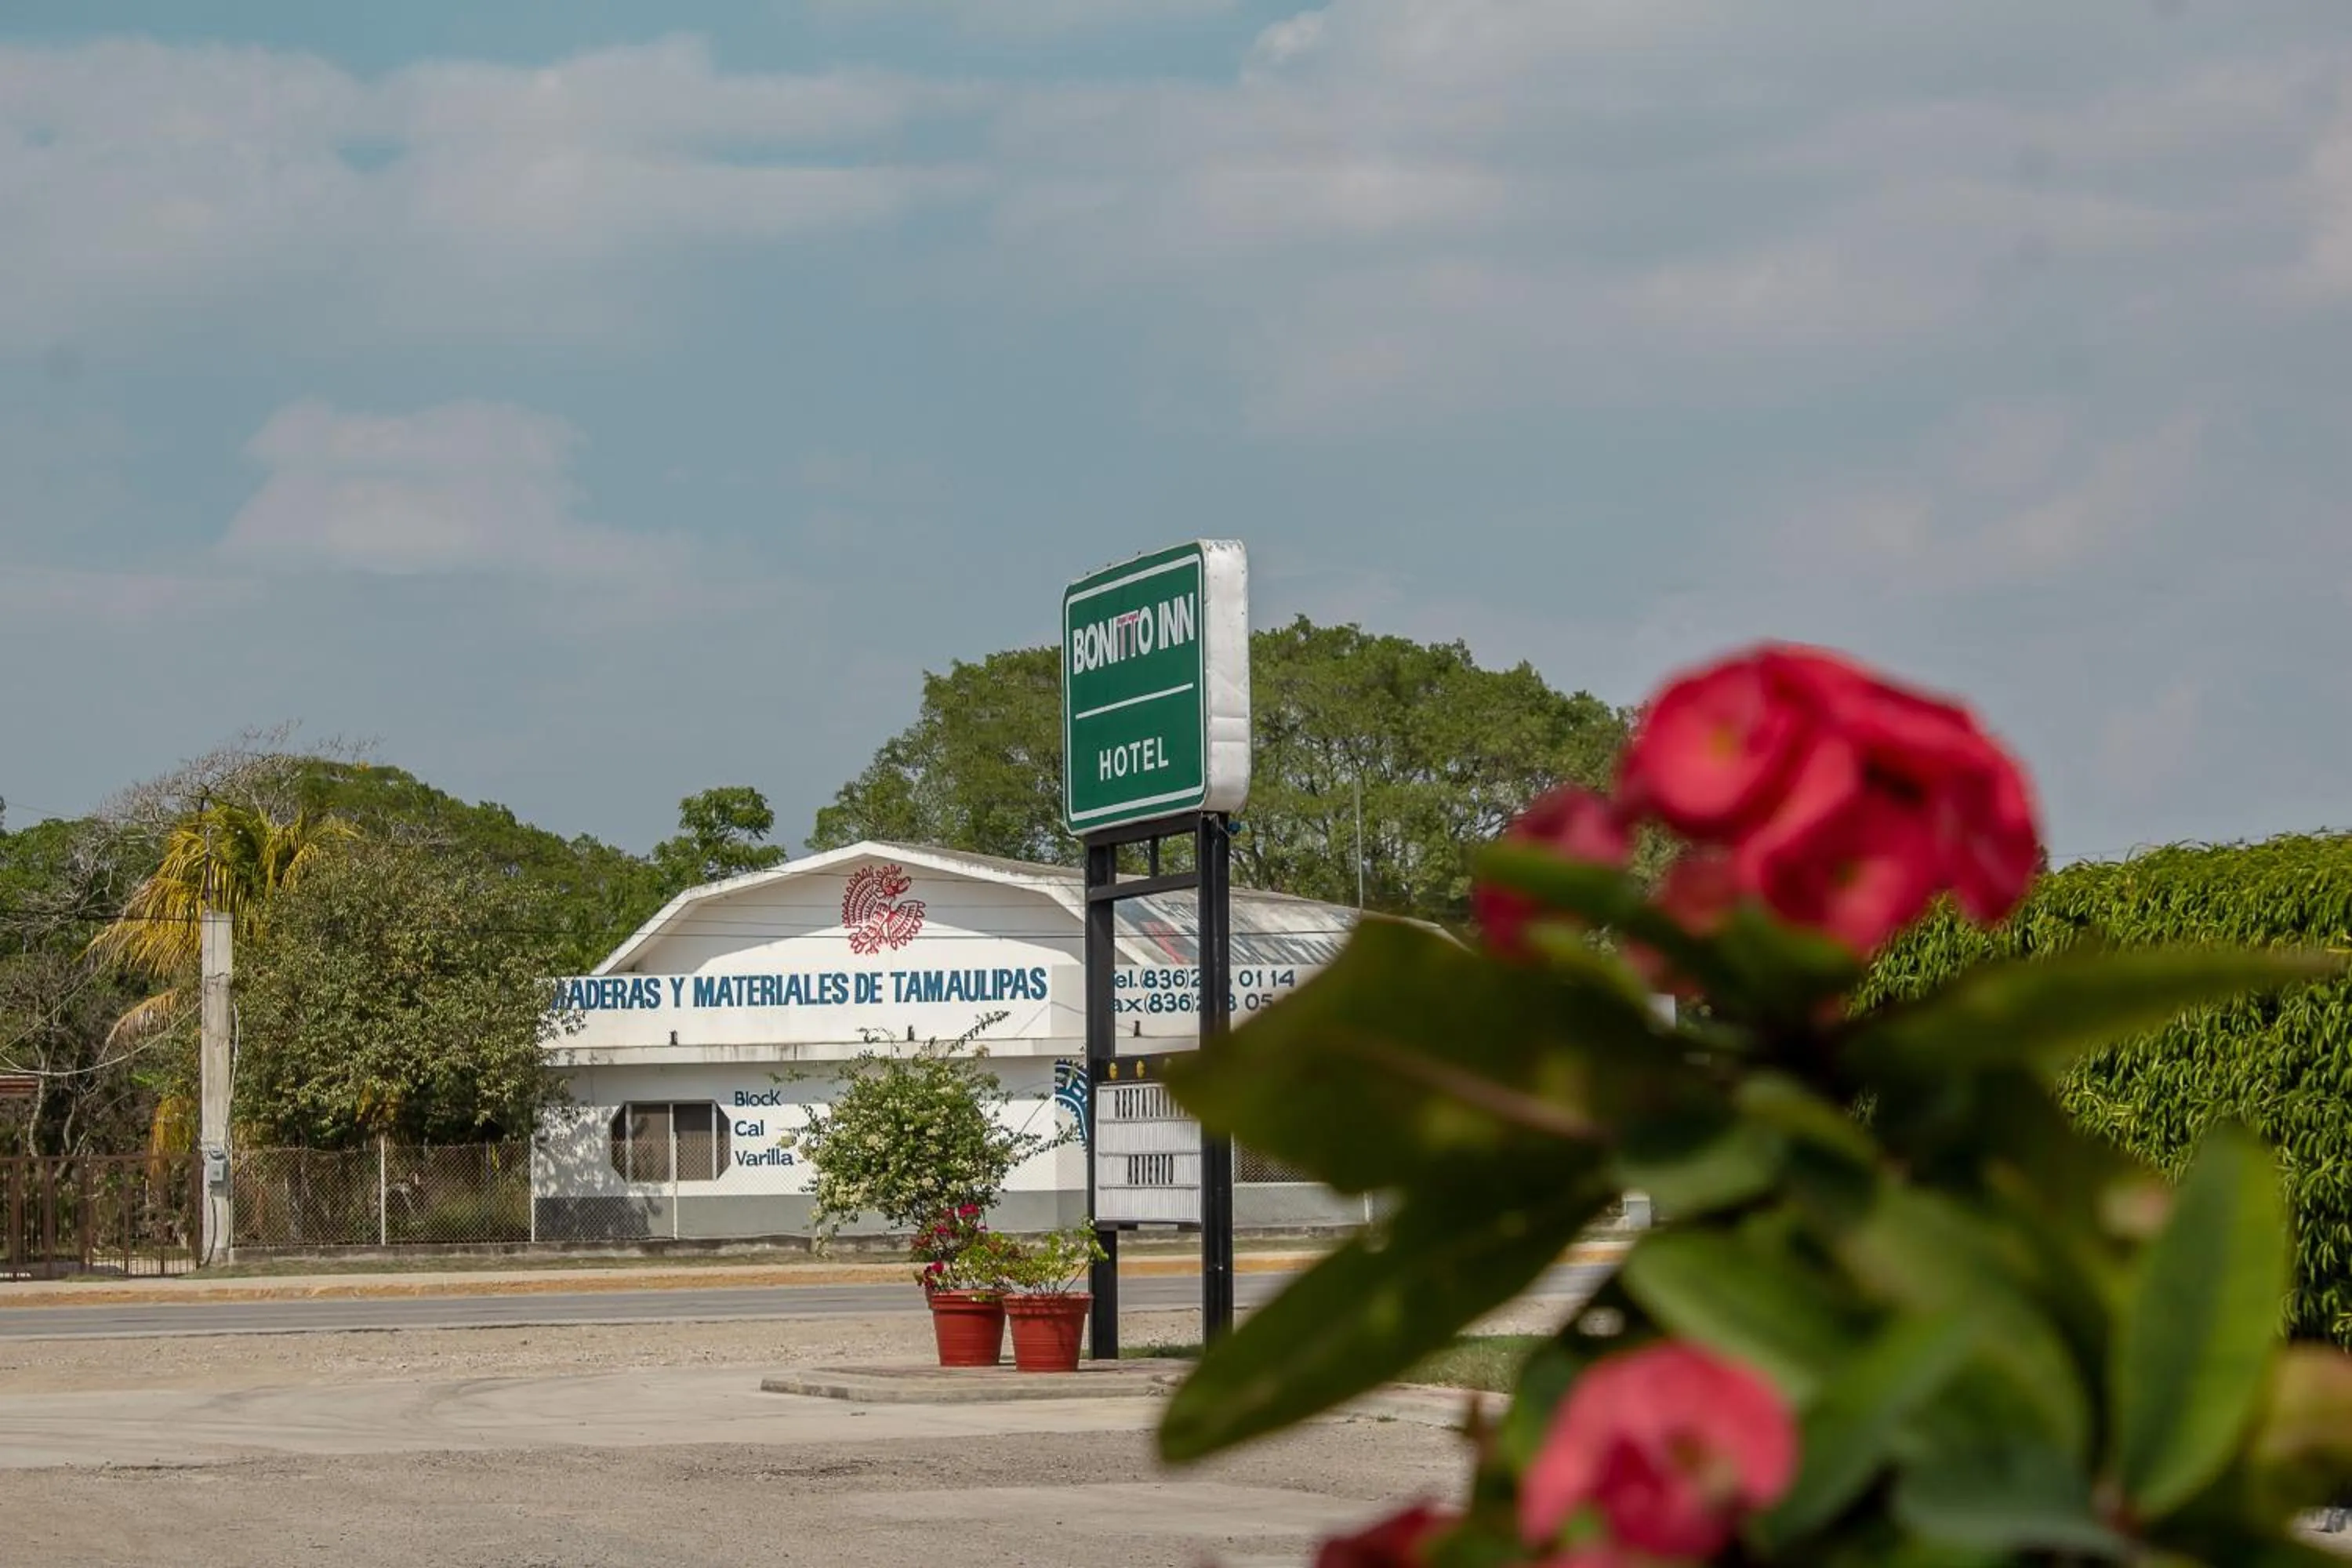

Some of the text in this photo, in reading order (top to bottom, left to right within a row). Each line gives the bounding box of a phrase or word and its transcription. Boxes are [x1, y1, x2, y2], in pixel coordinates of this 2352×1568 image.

[1073, 593, 1194, 675] BONITTO INN
[1099, 737, 1169, 782] HOTEL
[670, 977, 685, 1007] Y
[693, 972, 850, 1007] MATERIALES
[855, 972, 883, 1004] DE
[890, 967, 1047, 1004] TAMAULIPAS
[735, 1120, 764, 1137] Cal
[735, 1148, 793, 1167] Varilla
